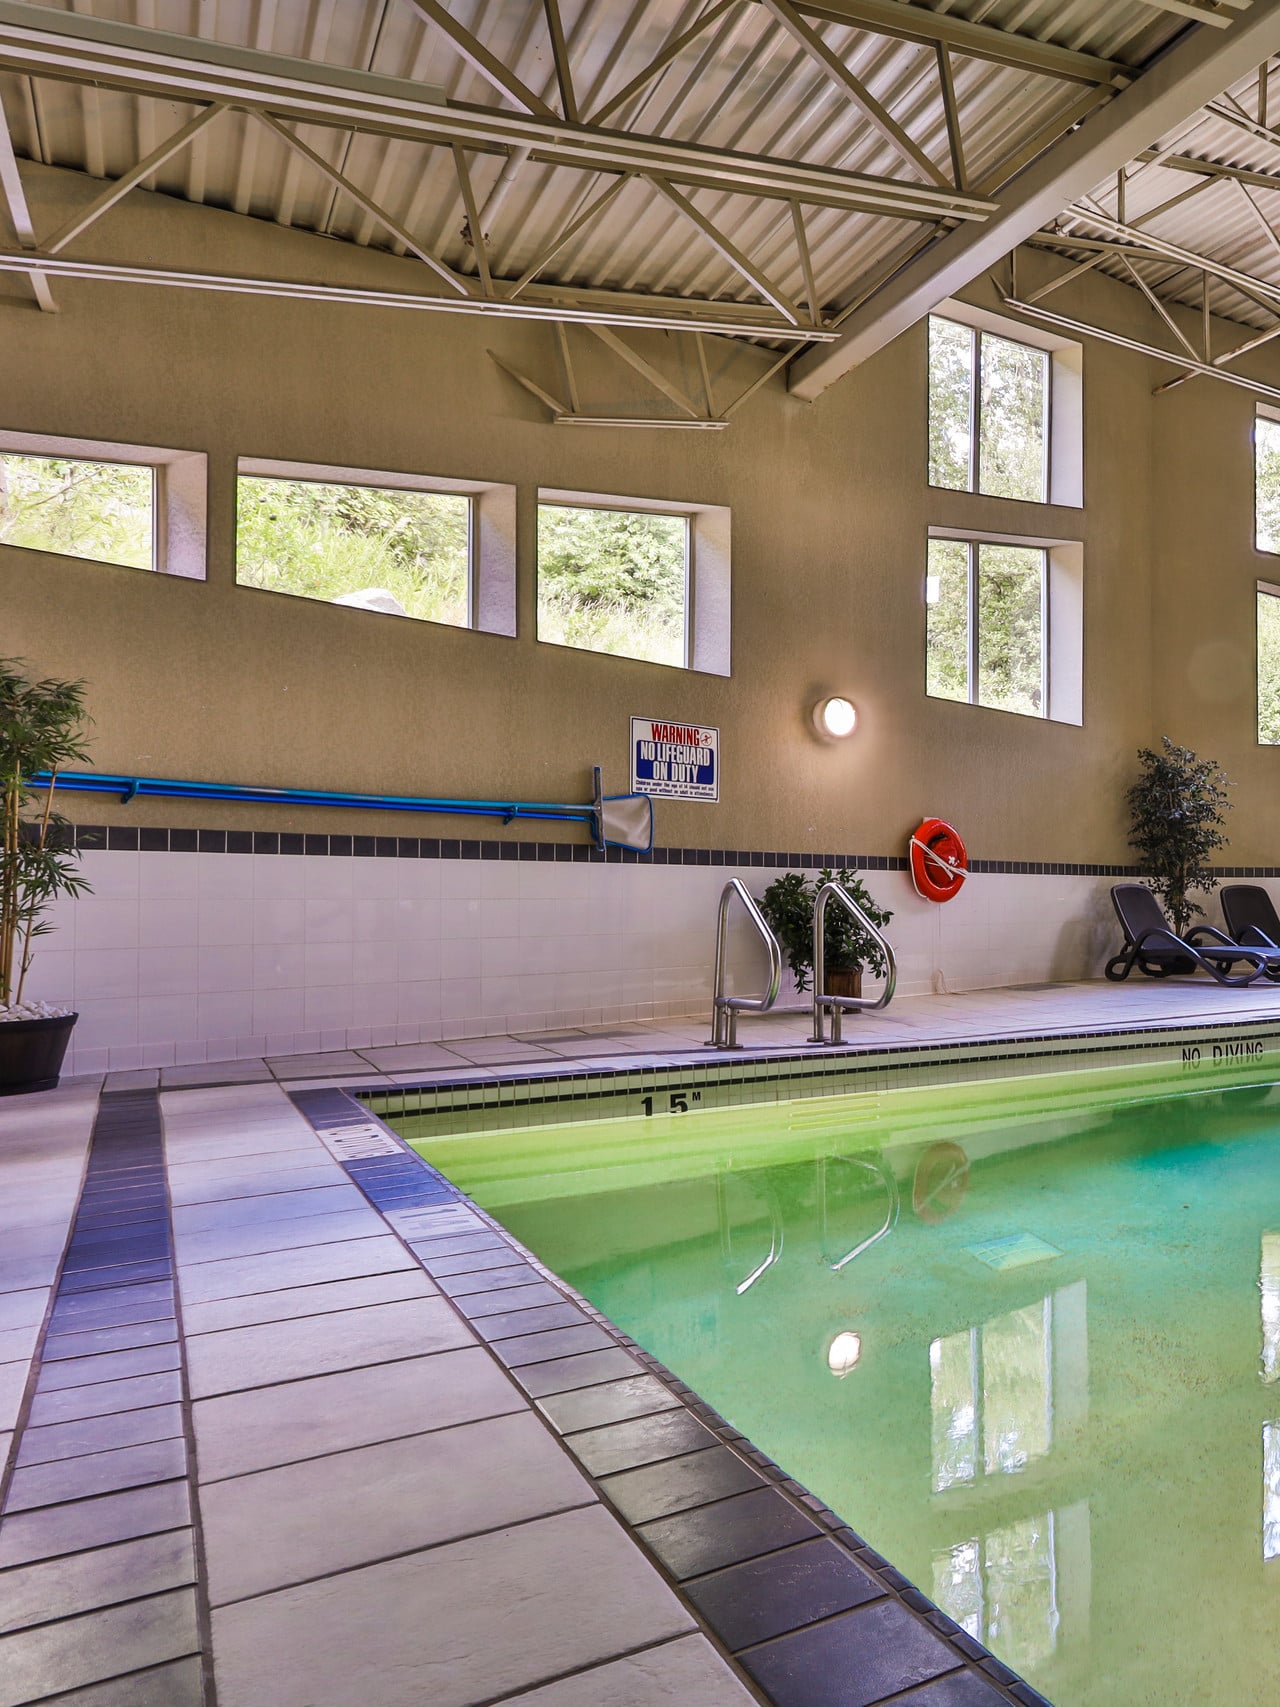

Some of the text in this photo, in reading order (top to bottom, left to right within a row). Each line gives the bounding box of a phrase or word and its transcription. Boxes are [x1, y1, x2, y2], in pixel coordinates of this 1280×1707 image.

[651, 723, 700, 746] WARNING
[640, 741, 710, 767] NO LIFEGUARD
[652, 760, 699, 783] ON DUTY
[1182, 1041, 1264, 1062] NO DIVING
